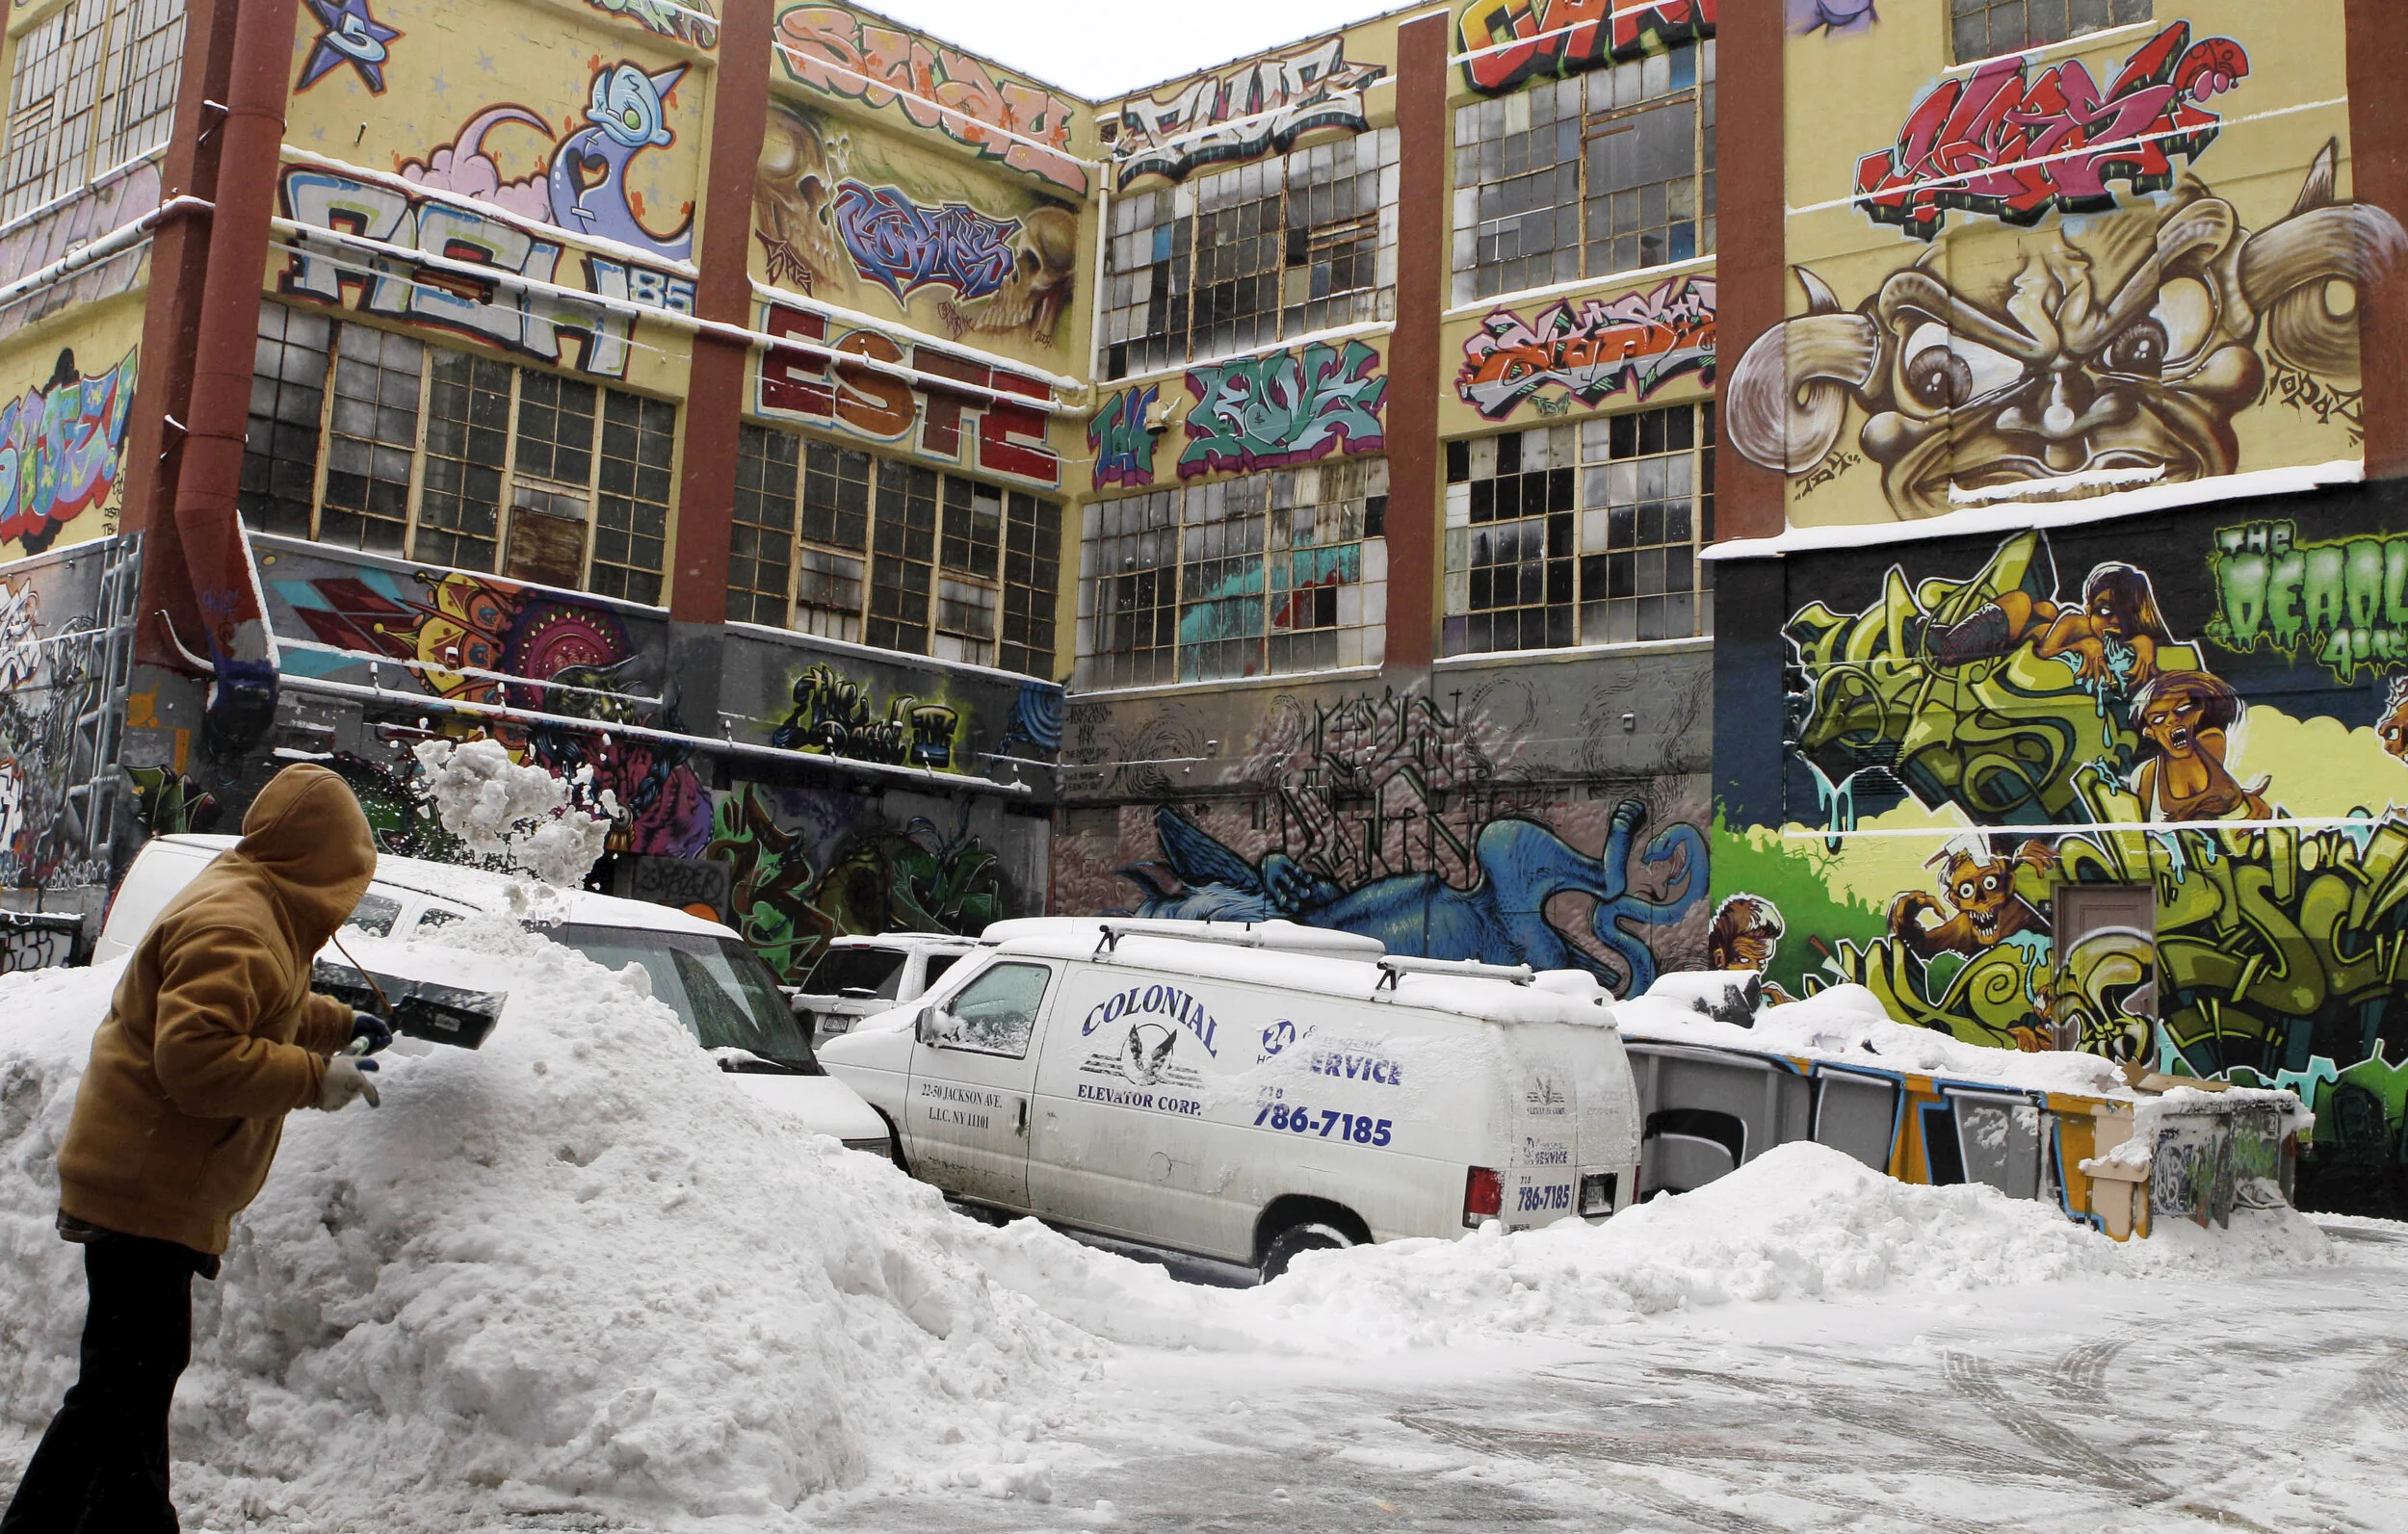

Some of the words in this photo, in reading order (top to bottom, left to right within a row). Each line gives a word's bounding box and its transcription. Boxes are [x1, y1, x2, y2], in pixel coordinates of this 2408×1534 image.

[1082, 984, 1217, 1059] COLONIAL
[1264, 1022, 1294, 1051] 24
[1310, 1052, 1403, 1086] ERVICE
[922, 1083, 943, 1098] 22-50
[943, 1086, 982, 1105] JACKSON
[983, 1093, 1003, 1108] AVE.
[1078, 1083, 1154, 1108] ELEVATOR
[1158, 1096, 1202, 1116] CORP.
[929, 1106, 951, 1123] L.I.C.
[953, 1110, 965, 1125] NY
[968, 1113, 989, 1129] 11101
[1253, 1101, 1393, 1147] 786-7185
[1518, 1184, 1570, 1211] 786-7185
